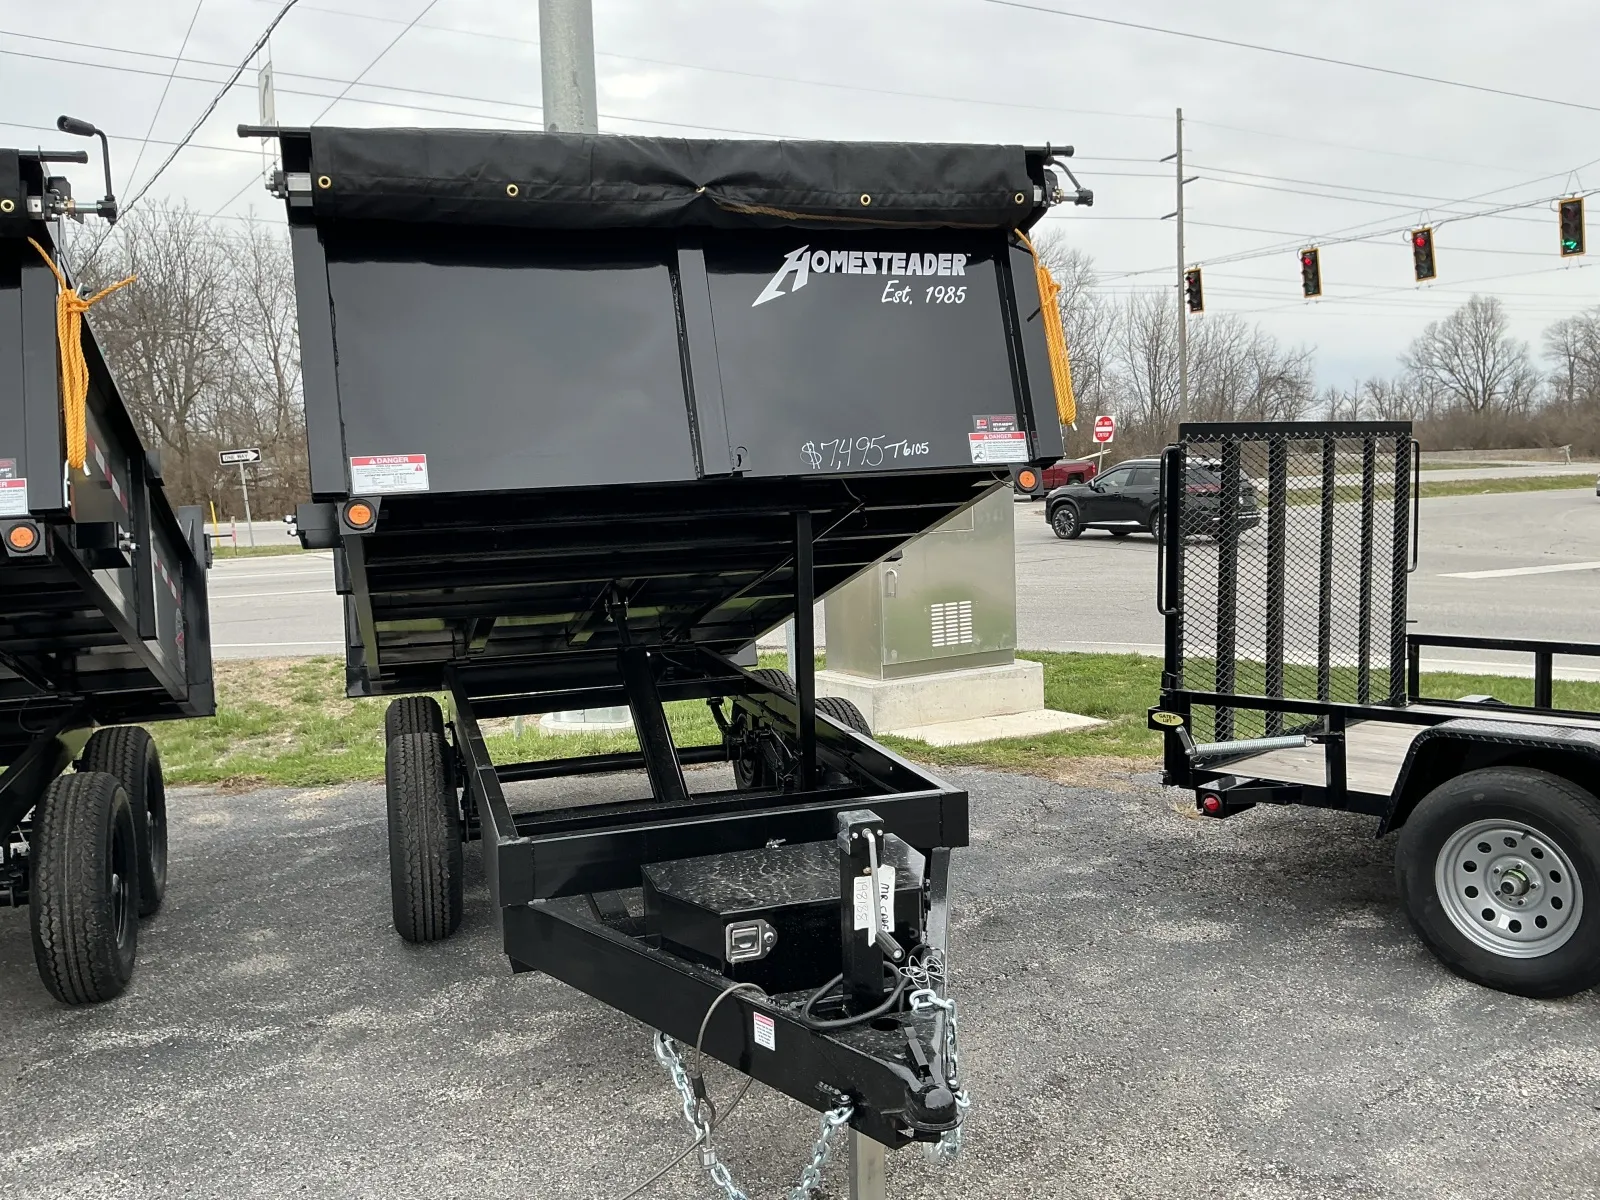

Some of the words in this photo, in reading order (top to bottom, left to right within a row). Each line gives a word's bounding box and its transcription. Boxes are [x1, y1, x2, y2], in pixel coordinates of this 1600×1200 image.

[752, 245, 967, 307] HOMESTEADER
[881, 280, 913, 305] Est.
[925, 286, 967, 304] 1985
[376, 456, 409, 464] DANGER
[800, 435, 885, 470] $7,495
